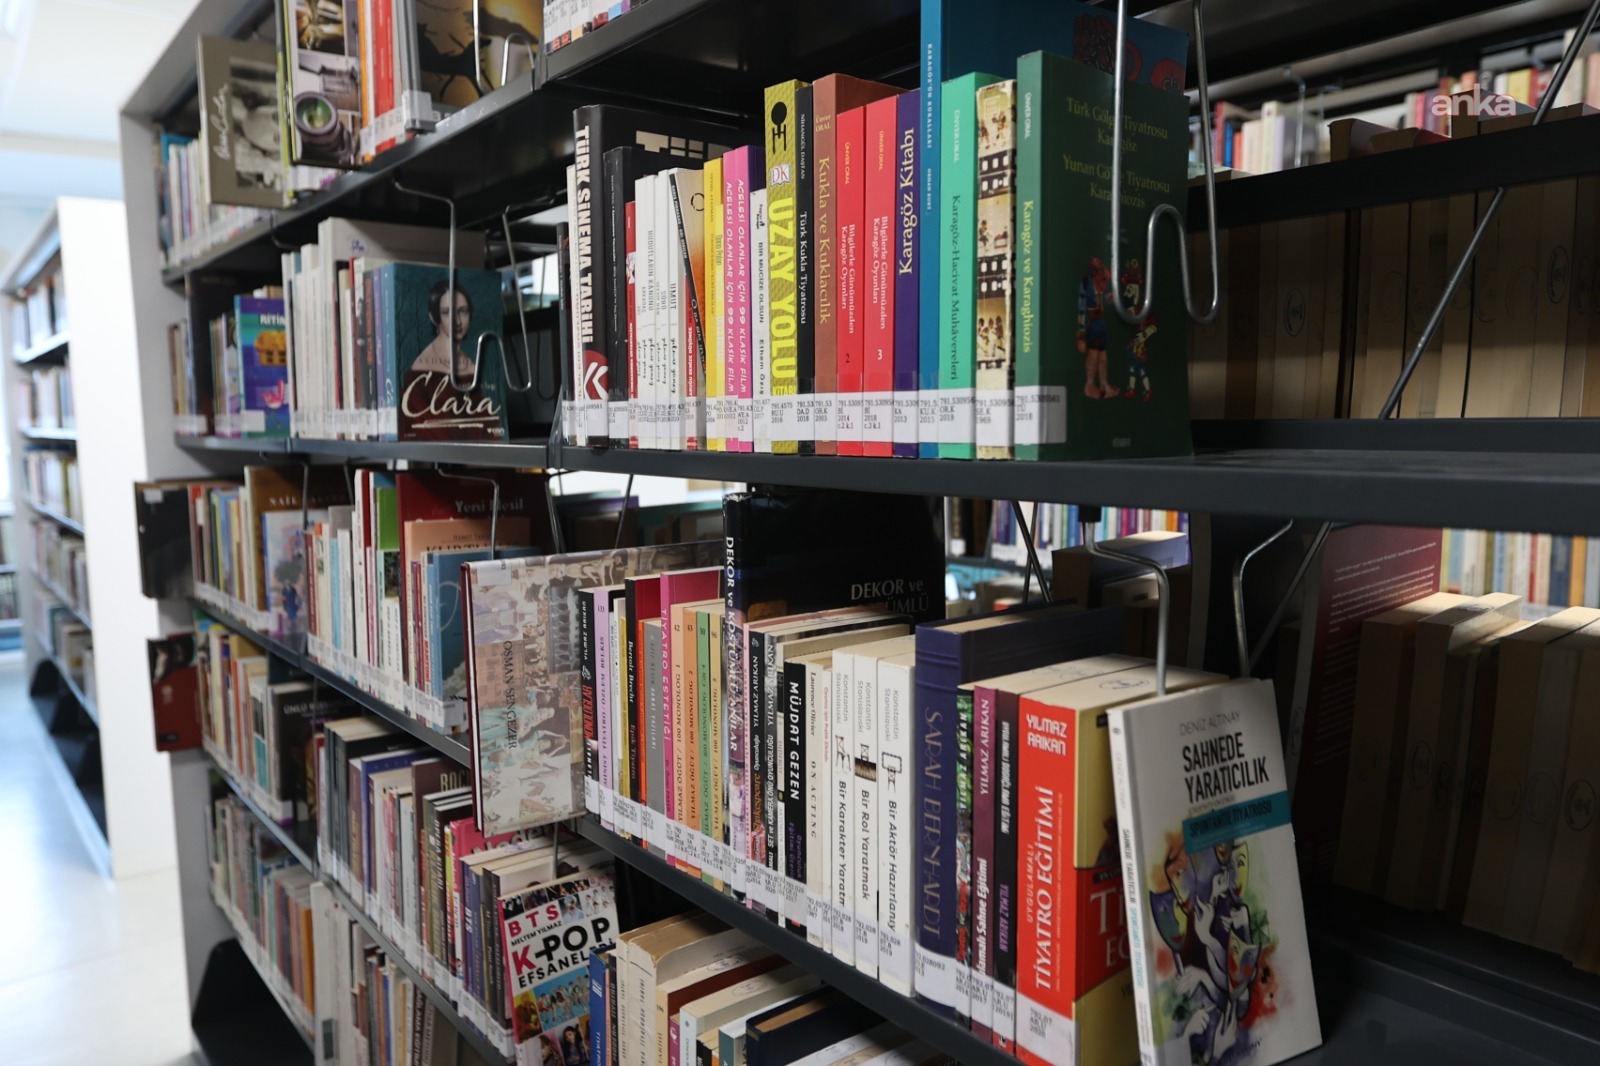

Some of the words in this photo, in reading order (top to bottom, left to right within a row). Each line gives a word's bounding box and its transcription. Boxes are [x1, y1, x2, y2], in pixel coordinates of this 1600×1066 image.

[1067, 97, 1090, 118] Türk
[1121, 115, 1168, 139] Tiyatrosu
[576, 126, 591, 185] TÜRK
[899, 128, 915, 189] Kitabı
[1063, 154, 1095, 176] Yunan
[1125, 170, 1169, 193] Tiyatrosu
[725, 182, 735, 224] ACELESİ
[737, 179, 746, 222] ACELESİ
[818, 156, 830, 209] Kukla
[577, 188, 592, 271] SİNEMA
[769, 197, 795, 280] UZAY
[799, 211, 808, 238] Türk
[819, 213, 829, 234] ve
[840, 226, 849, 264] Karagöz
[871, 218, 880, 258] Karagöz
[880, 216, 889, 260] Bilgilerle
[899, 192, 918, 276] Karagöz
[1020, 200, 1034, 255] Karagöz
[725, 228, 735, 277] OLANLAR
[737, 226, 746, 277] OLANLAR
[800, 240, 808, 273] Kukla
[847, 224, 856, 268] Bilgilerle
[1022, 258, 1032, 273] ve
[669, 283, 677, 310] UMUT
[725, 282, 735, 303] İÇİN
[737, 281, 747, 303] İÇİN
[799, 275, 808, 324] Tiyatrosu
[819, 239, 831, 324] Kuklacılık
[840, 266, 848, 309] Oyunları
[847, 270, 856, 334] Günümüzden
[872, 260, 880, 304] Oyunları
[880, 262, 888, 329] Günümüzden
[579, 273, 593, 343] TARİHİ
[727, 307, 735, 325] 99
[738, 306, 747, 325] 99
[1020, 276, 1034, 353] Karaghiozis
[727, 328, 736, 364] KLASİK
[738, 328, 747, 364] KLASİK
[770, 293, 797, 379] YOLU
[401, 371, 502, 418] Clara
[727, 367, 736, 393] FİLM
[739, 367, 748, 393] FİLM
[455, 499, 485, 513] Yeni
[725, 537, 735, 587] DEKOR
[727, 591, 735, 607] ve
[850, 579, 904, 601] DEKOR
[908, 580, 924, 592] ve
[627, 641, 635, 671] Bertolt
[660, 609, 669, 669] TİYATRO
[727, 611, 739, 695] KOSTÜMLÜ
[502, 641, 515, 683] OSMAN
[581, 685, 594, 740] MONOLOGLAR
[662, 676, 671, 740] ESTETİĞİ
[789, 682, 802, 745] MÜJDAT
[842, 674, 850, 721] Konstantin
[865, 682, 873, 730] Konstantin
[892, 690, 900, 739] Konstantin
[629, 724, 637, 744] Epik
[729, 698, 738, 751] ANILAR
[960, 713, 968, 760] ARIKAN
[980, 699, 990, 747] ARIKAN
[1026, 715, 1068, 738] YILMAZ
[1027, 732, 1067, 756] ARIKAN
[629, 748, 637, 779] Tiyatro
[810, 761, 817, 779] ON
[924, 706, 943, 790] SARAH
[1182, 732, 1245, 772] SAHNEDE
[789, 751, 801, 800] GEZEN
[839, 781, 847, 799] Bir
[960, 765, 968, 810] YILMAZ
[979, 749, 989, 795] YILMAZ
[1185, 756, 1270, 803] YARATICILIK
[766, 796, 774, 824] KAMERA
[861, 790, 870, 809] Bir
[888, 801, 898, 819] Bir
[838, 802, 847, 860] Karakter
[861, 812, 870, 832] Rol
[888, 823, 898, 860] Aktör
[1033, 785, 1054, 886] EĞİTİMİ
[861, 836, 870, 900] Yaratmak
[923, 797, 941, 938] BERNHARDT
[976, 857, 990, 896] Eğitimi
[1025, 843, 1035, 923] UYGULAMALI
[887, 863, 898, 932] Hazırlanıy
[976, 899, 988, 936] Sahne
[999, 884, 1009, 917] YILMAZ
[507, 904, 559, 938] BTS
[999, 917, 1009, 952] ARIKAN
[1033, 890, 1053, 990] TİYATRO
[512, 917, 611, 976] K-POP
